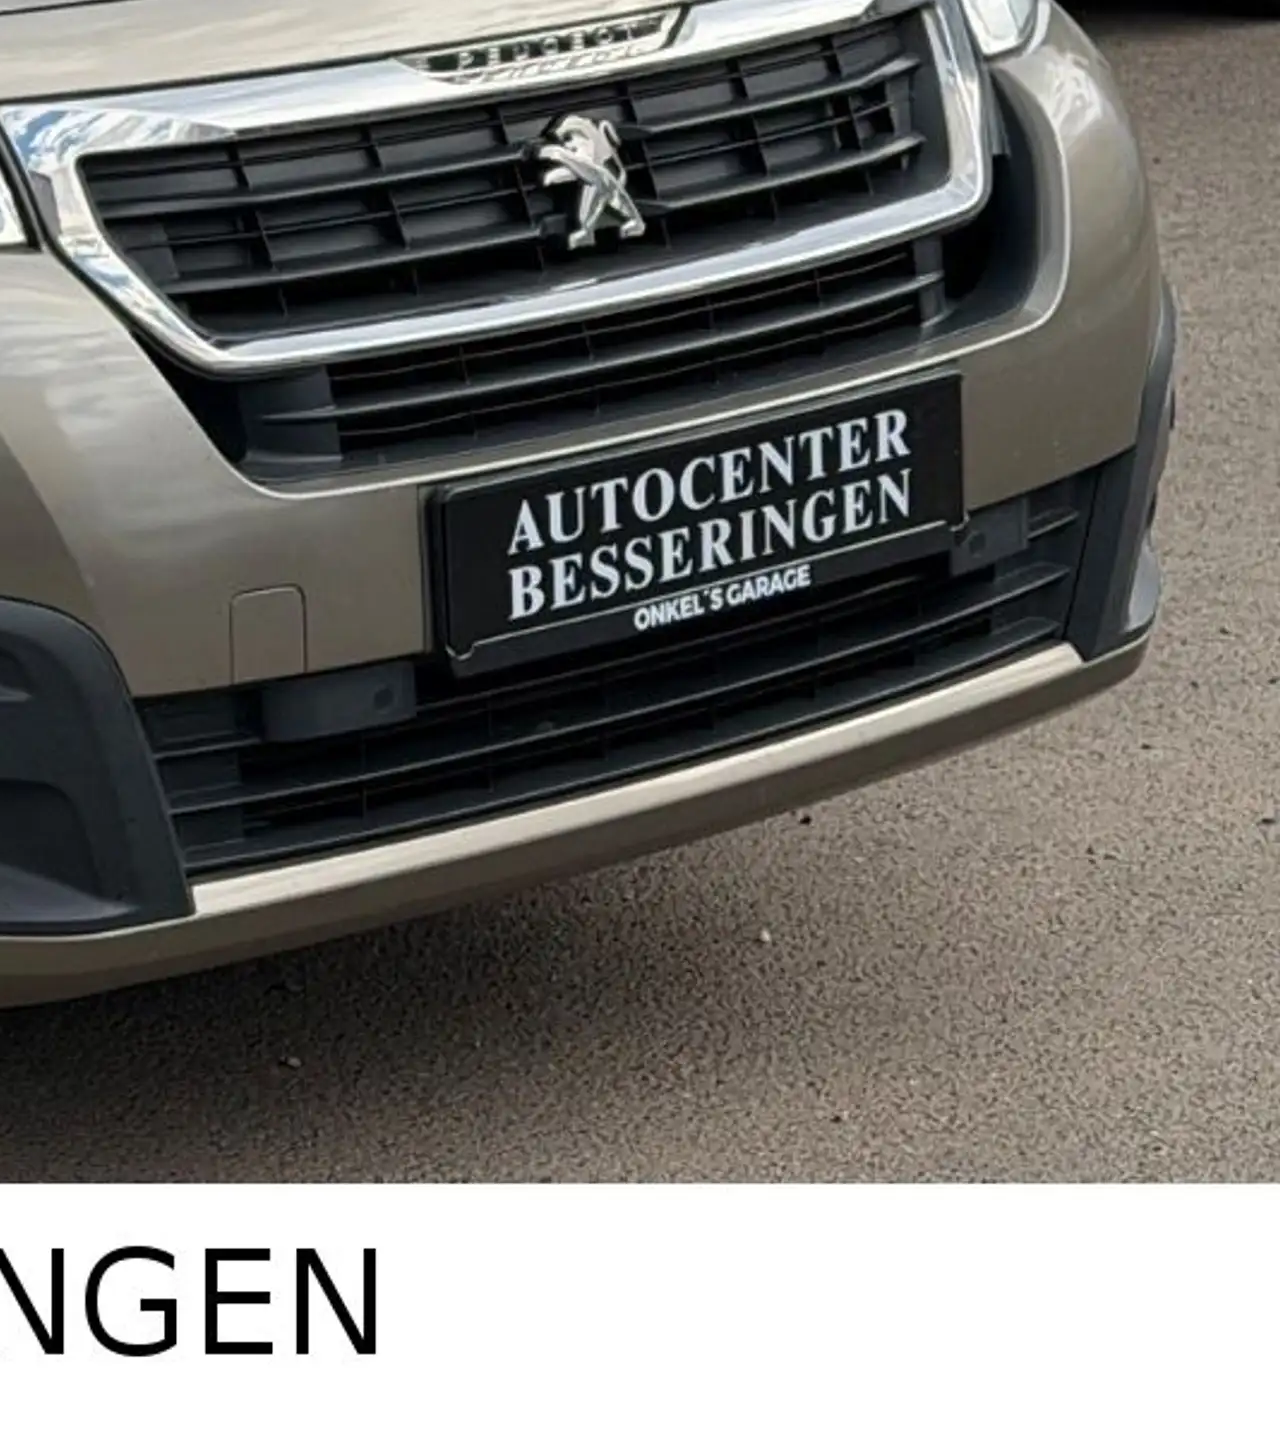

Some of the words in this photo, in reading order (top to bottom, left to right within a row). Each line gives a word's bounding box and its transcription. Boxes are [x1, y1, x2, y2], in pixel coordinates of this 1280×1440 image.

[457, 22, 639, 71] PEUGEOT
[508, 409, 911, 555] AUTOCENTER
[508, 468, 912, 621] BESSERINGEN
[725, 563, 811, 607] GARAGE
